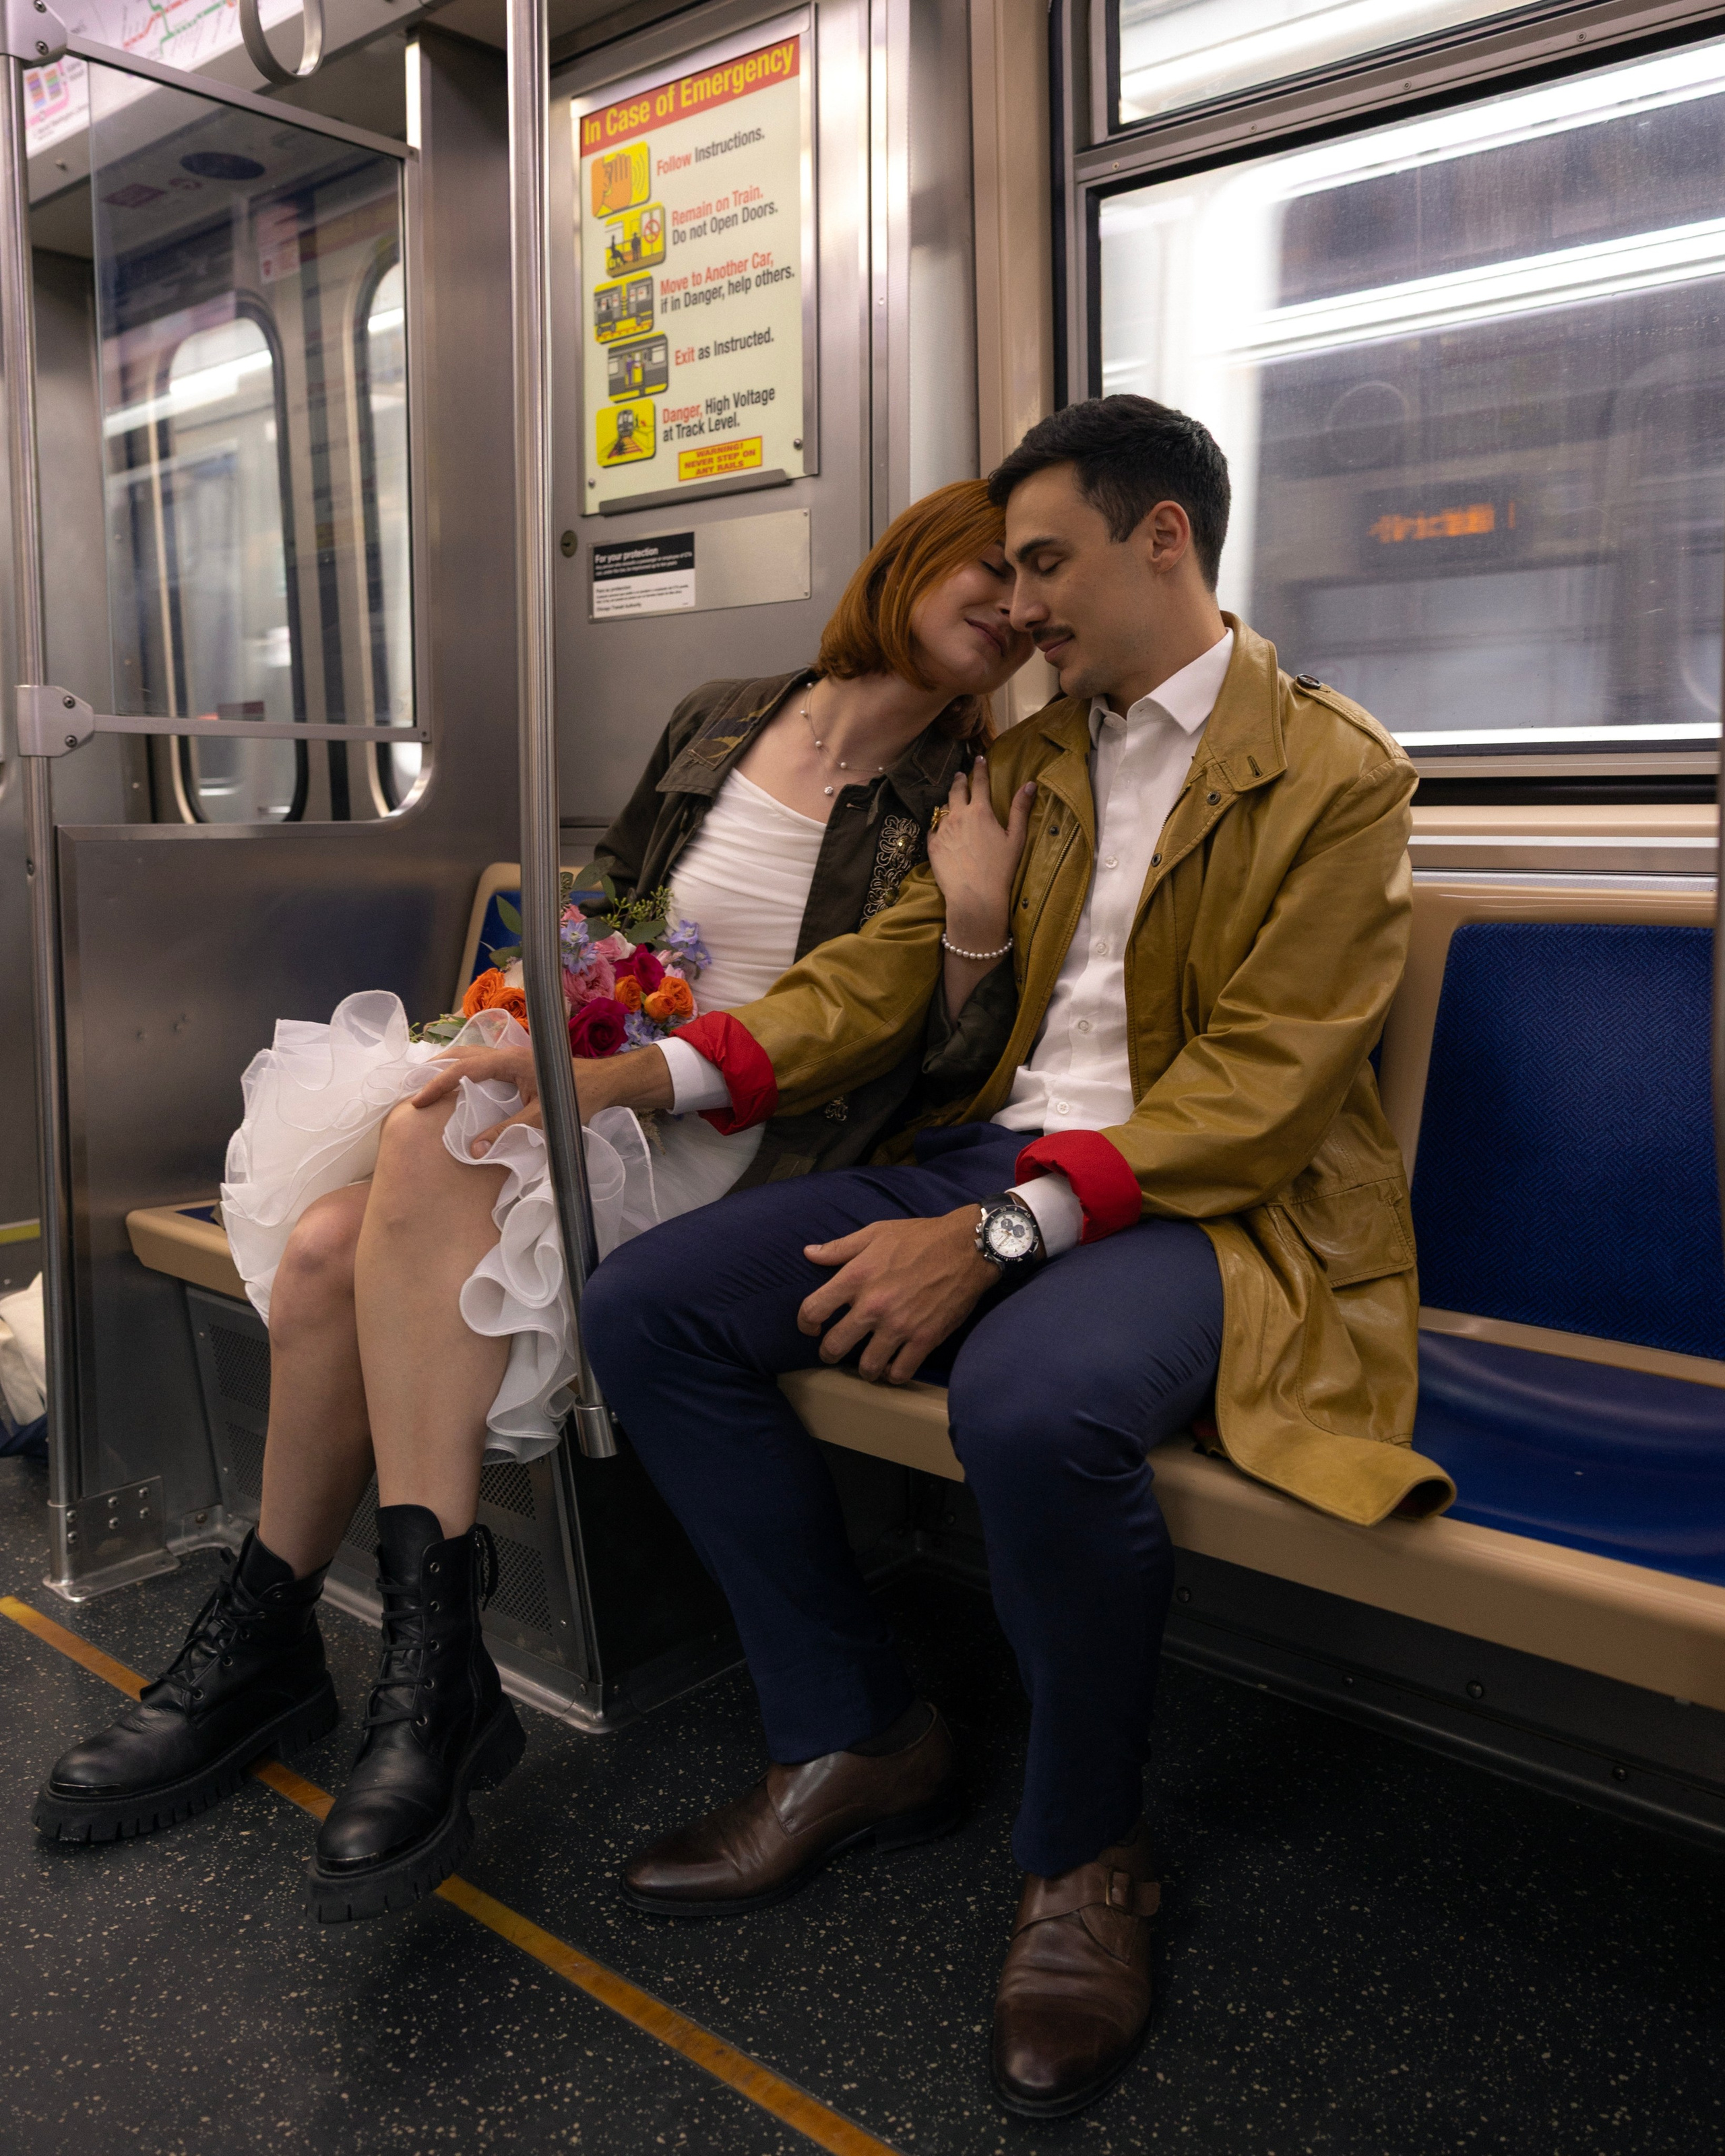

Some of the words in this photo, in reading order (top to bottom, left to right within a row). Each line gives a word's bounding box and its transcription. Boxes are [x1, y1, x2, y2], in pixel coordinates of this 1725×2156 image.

[584, 119, 601, 146] In
[606, 100, 650, 136] Case
[656, 84, 675, 117] of
[681, 43, 794, 108] Emergency
[656, 153, 692, 176] Follow
[695, 127, 765, 162] Instructions.
[671, 201, 712, 226] Remain
[716, 197, 730, 212] on
[732, 185, 763, 207] Train.
[672, 229, 687, 245] Do
[689, 220, 707, 240] not
[710, 213, 739, 234] Open
[742, 201, 778, 223] Doors.
[660, 276, 689, 295] Move
[691, 272, 702, 287] to
[705, 258, 749, 283] Another
[751, 251, 774, 269] Car,
[660, 298, 668, 314] if
[670, 296, 681, 311] in
[684, 285, 725, 307] Danger,
[728, 276, 751, 295] help
[755, 265, 795, 288] others.
[675, 346, 695, 366] Exit
[698, 346, 711, 360] as
[714, 326, 774, 356] Instructed.
[662, 404, 703, 424] Danger,
[705, 395, 730, 415] High
[733, 387, 776, 408] Voltage
[663, 426, 673, 441] at
[675, 419, 705, 439] Track
[708, 412, 741, 433] Level.
[684, 457, 714, 469] NEVER
[717, 452, 739, 463] STEP
[743, 449, 755, 457] ON
[695, 466, 714, 475] ANY
[717, 460, 744, 471] RAILS
[696, 443, 743, 457] WARNING!
[595, 554, 606, 564] For
[607, 552, 622, 564] your
[623, 547, 659, 561] protection
